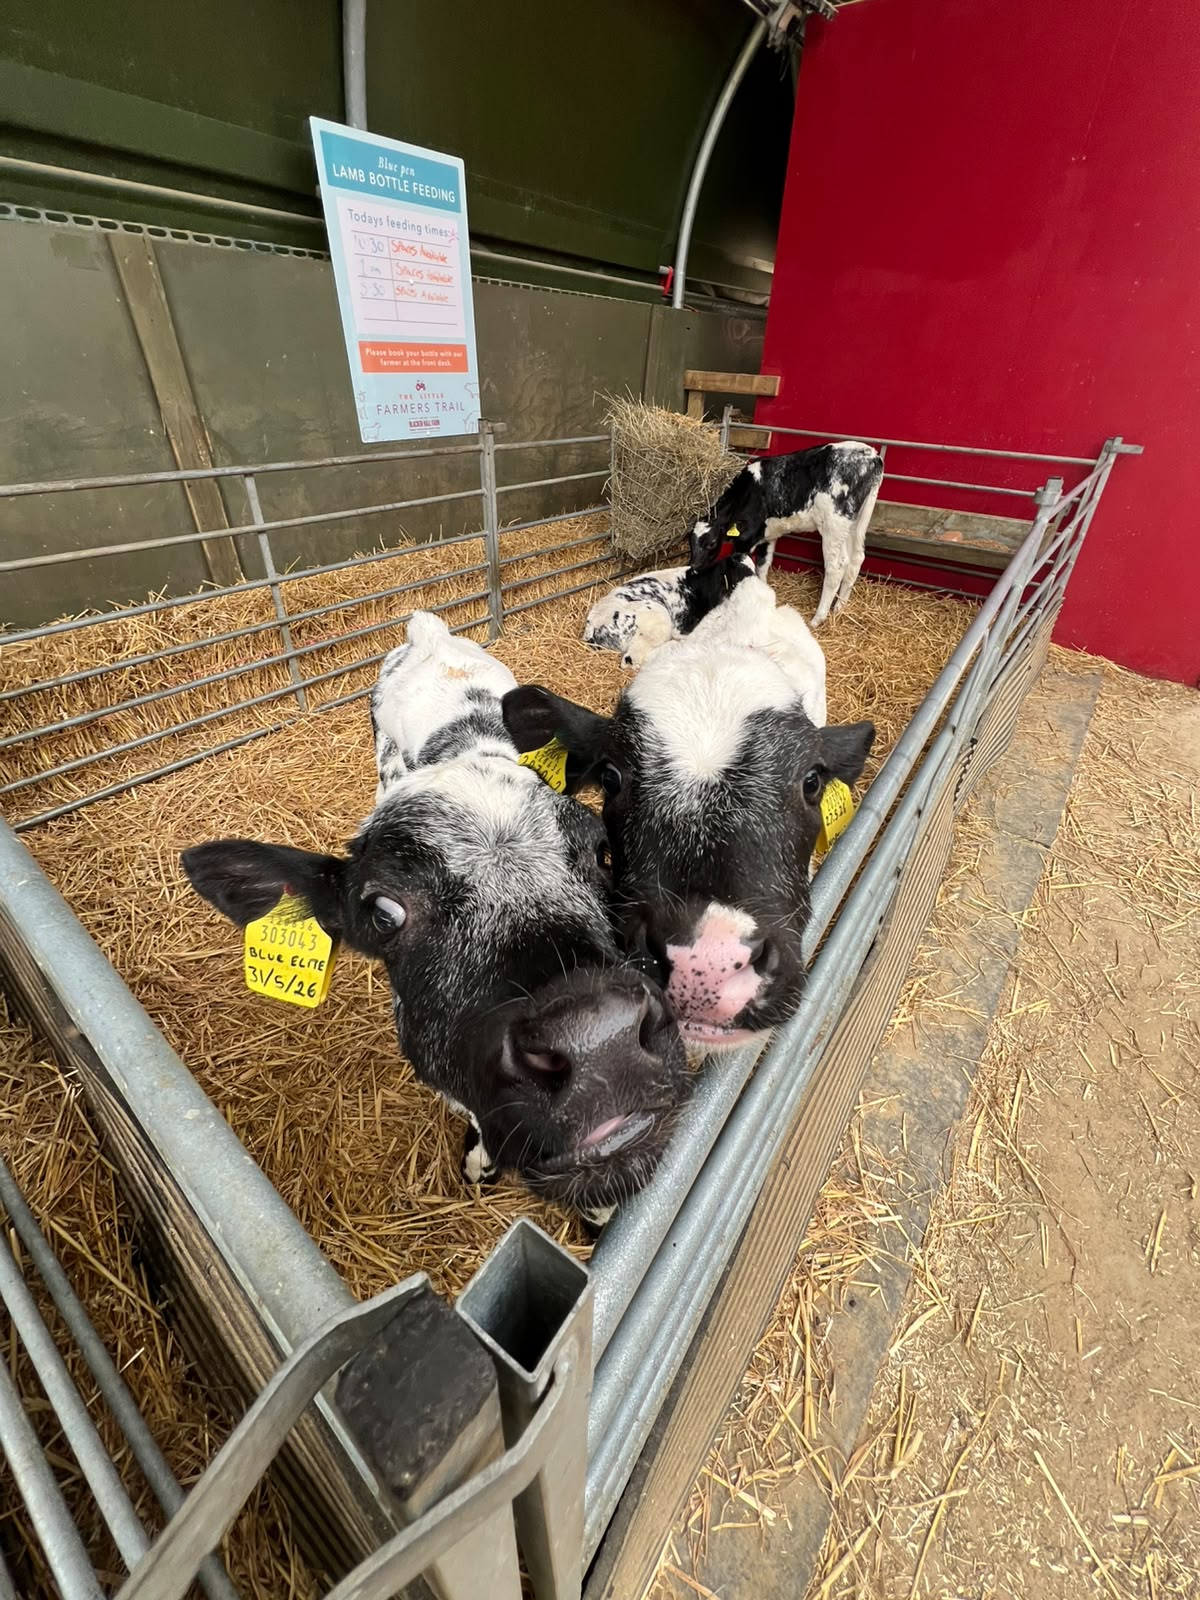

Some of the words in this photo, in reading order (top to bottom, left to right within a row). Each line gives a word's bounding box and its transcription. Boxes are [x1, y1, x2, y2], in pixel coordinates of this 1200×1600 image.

[378, 156, 398, 173] Blue
[400, 166, 415, 178] pen
[332, 163, 365, 183] LAMB
[370, 173, 409, 193] BOTTLE
[412, 182, 456, 203] FEEDING
[348, 208, 384, 228] Todays
[386, 216, 422, 236] feeding
[365, 348, 386, 356] Please
[388, 348, 404, 356] book
[420, 349, 438, 358] bottle
[380, 358, 402, 366] farmer
[410, 358, 421, 366] the
[422, 358, 436, 366] front
[438, 358, 453, 367] desk.
[376, 402, 431, 415] FARMERS
[436, 401, 465, 412] TRAIL
[260, 925, 318, 952] 303043
[290, 956, 326, 972] ELITE
[248, 966, 318, 998] 31/5/26
